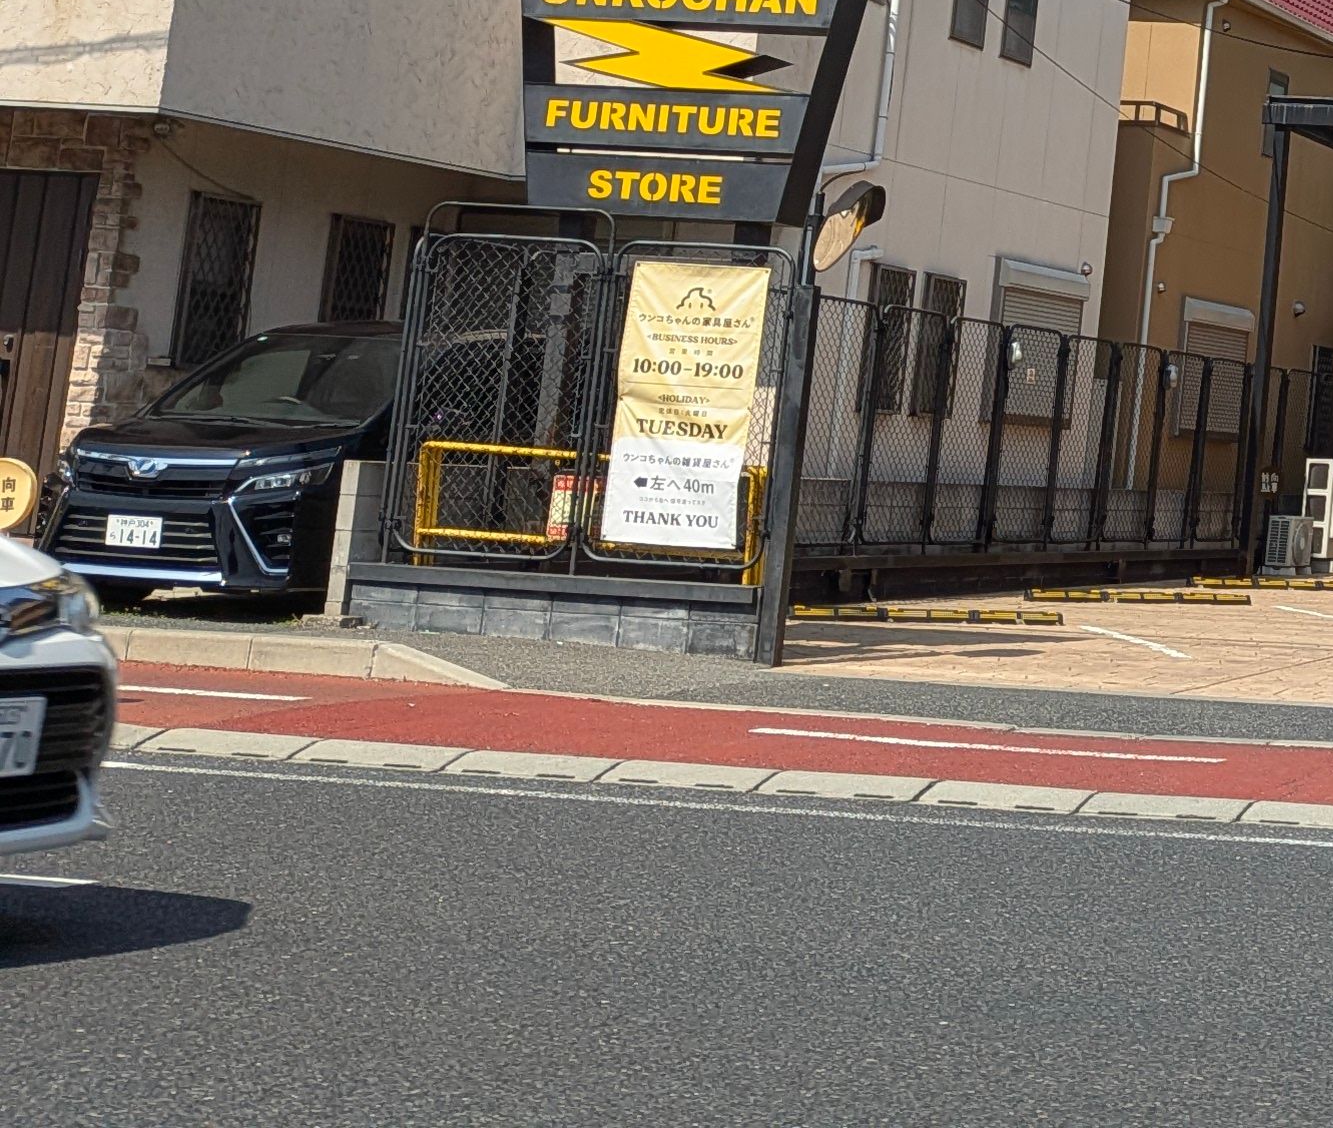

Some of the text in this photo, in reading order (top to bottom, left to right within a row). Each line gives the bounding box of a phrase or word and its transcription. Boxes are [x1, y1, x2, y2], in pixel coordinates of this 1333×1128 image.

[545, 99, 781, 138] FURNITURE
[587, 169, 723, 205] STORE
[639, 313, 751, 328] ウンコちゃんの家具屋さん
[636, 418, 728, 439] TUESDAY
[623, 510, 718, 528] THANK YOU
[120, 529, 157, 546] 14-14
